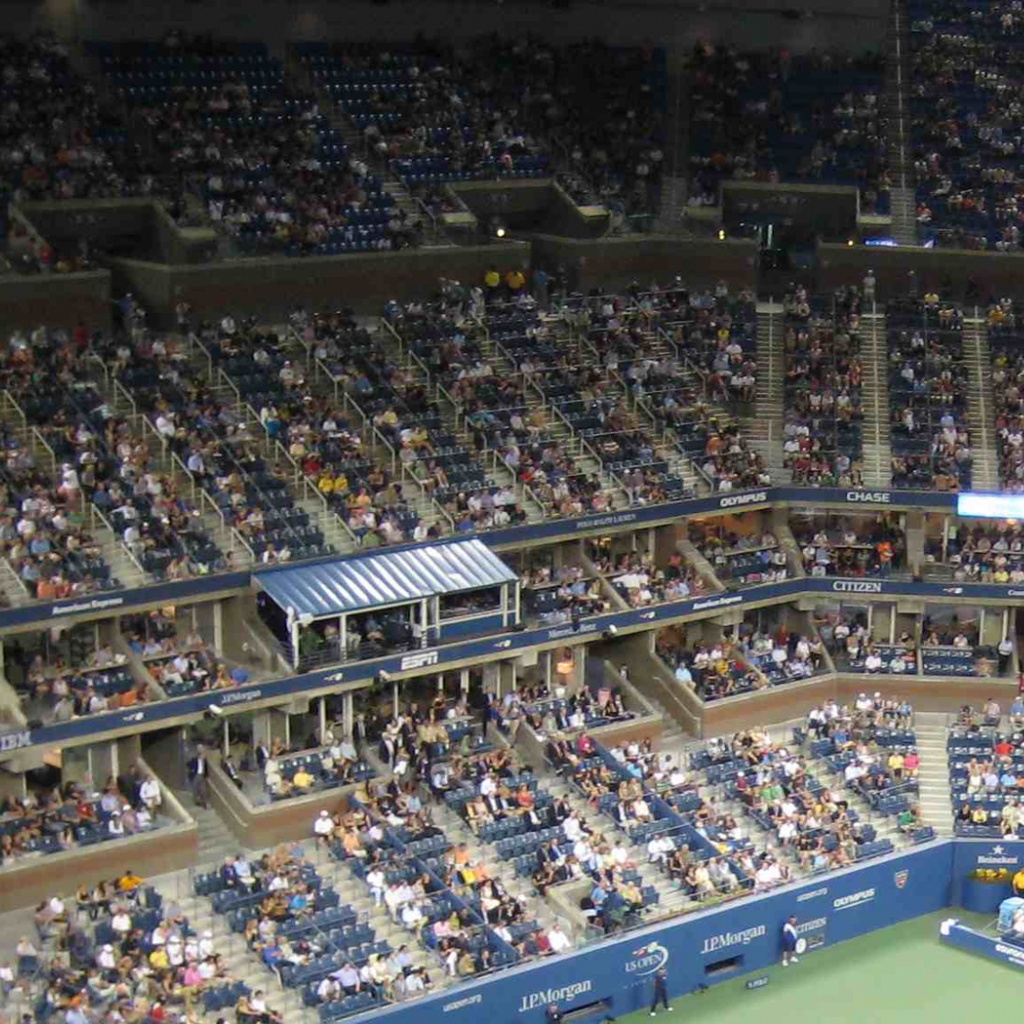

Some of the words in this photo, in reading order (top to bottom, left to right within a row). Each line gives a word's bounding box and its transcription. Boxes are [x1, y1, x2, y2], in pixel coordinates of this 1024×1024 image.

[720, 492, 767, 507] OLYMPUS
[847, 491, 891, 503] CHASE
[833, 581, 882, 592] CITIZEN
[401, 651, 438, 670] ESPN
[0, 731, 32, 751] IBM
[978, 855, 1018, 864] Heineken
[834, 889, 875, 907] OLYMPUS
[637, 955, 662, 970] OPEN
